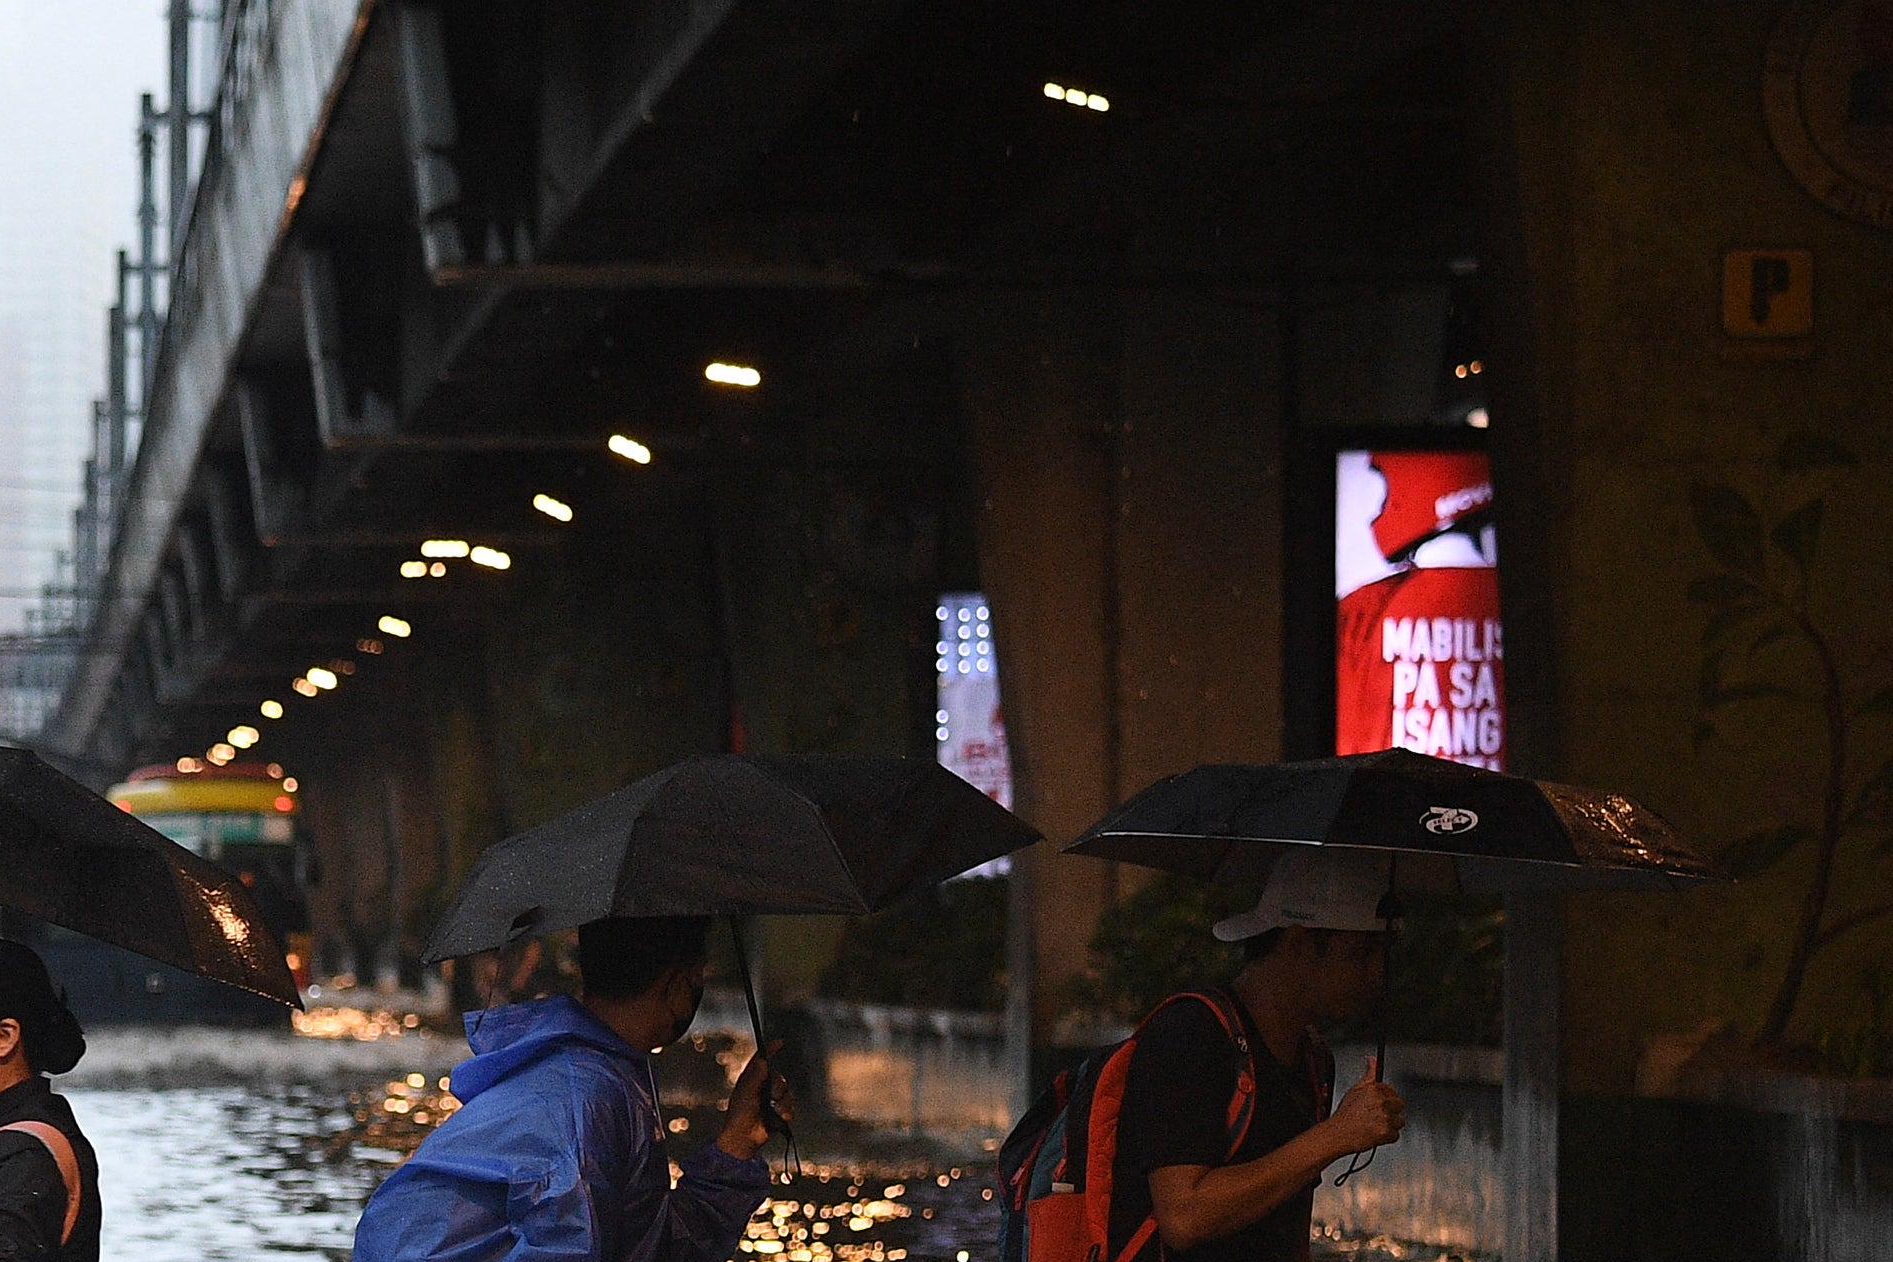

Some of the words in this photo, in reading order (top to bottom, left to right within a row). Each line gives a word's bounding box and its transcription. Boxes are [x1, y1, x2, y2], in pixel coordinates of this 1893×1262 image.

[1752, 258, 1789, 322] P
[1393, 662, 1440, 708] PA
[1450, 662, 1496, 708] SA
[1392, 709, 1500, 755] ISANG
